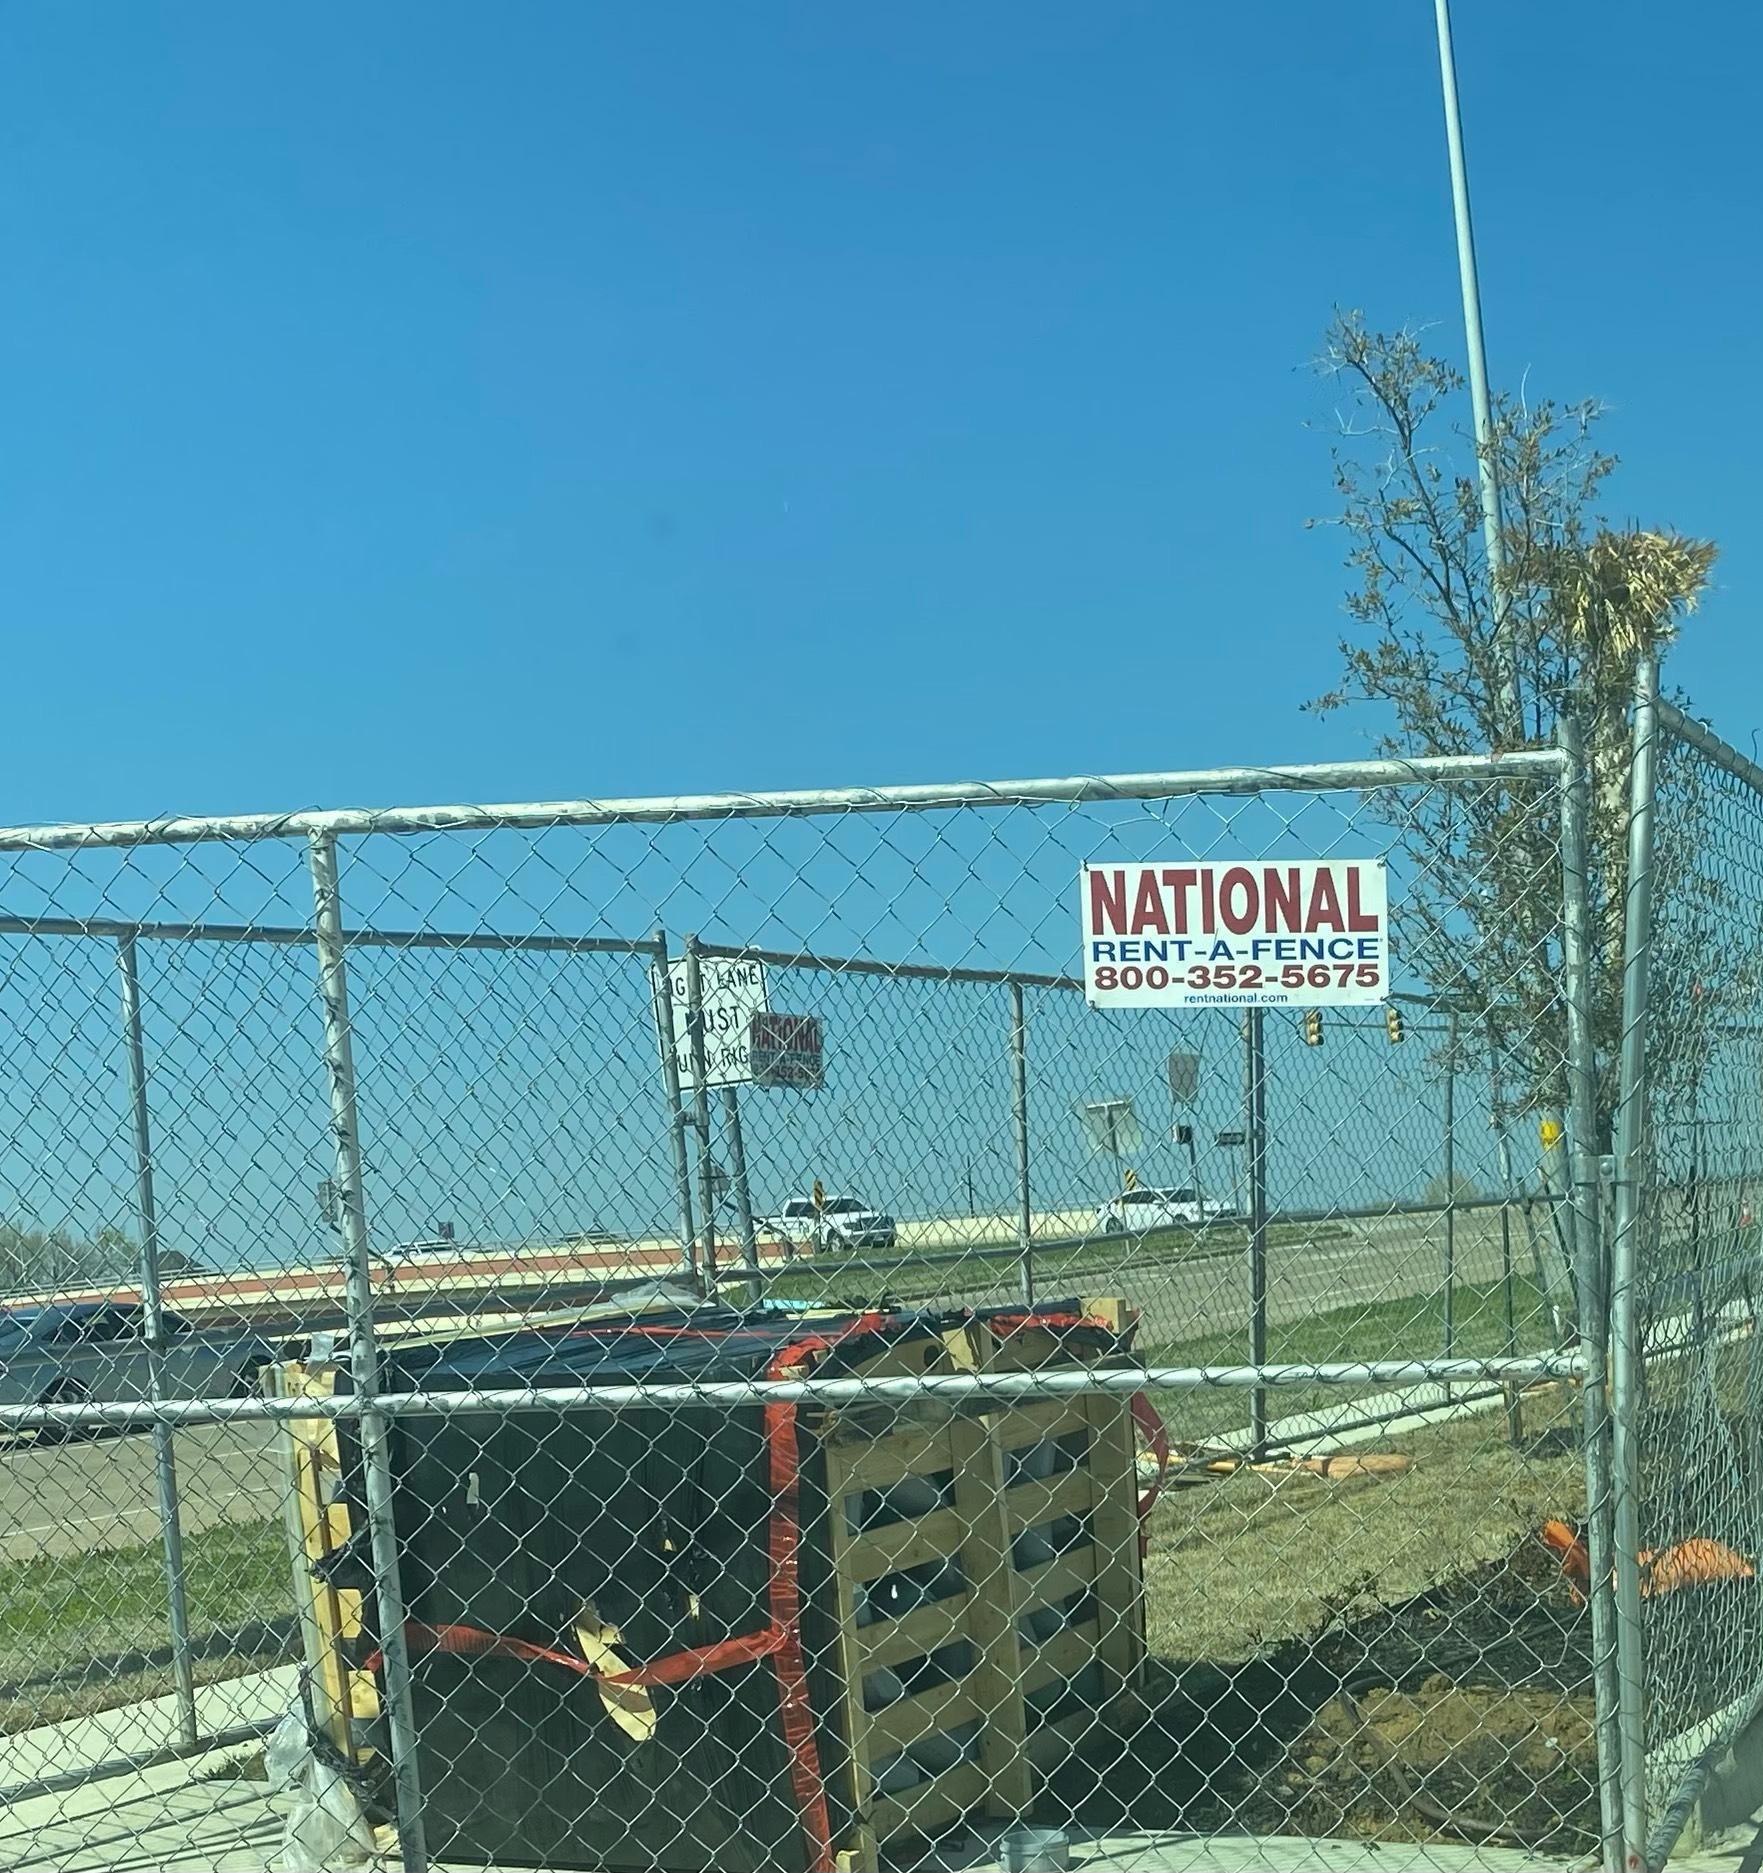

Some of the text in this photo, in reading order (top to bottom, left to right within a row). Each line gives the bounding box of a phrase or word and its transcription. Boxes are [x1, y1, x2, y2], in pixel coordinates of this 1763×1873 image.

[1089, 867, 1379, 935] NATIONAL
[1092, 938, 1380, 962] RENT-A-FENCE
[1094, 964, 1380, 990] 800-352-5675
[1184, 992, 1288, 1004] rentnational.com
[721, 1045, 750, 1067] RIG
